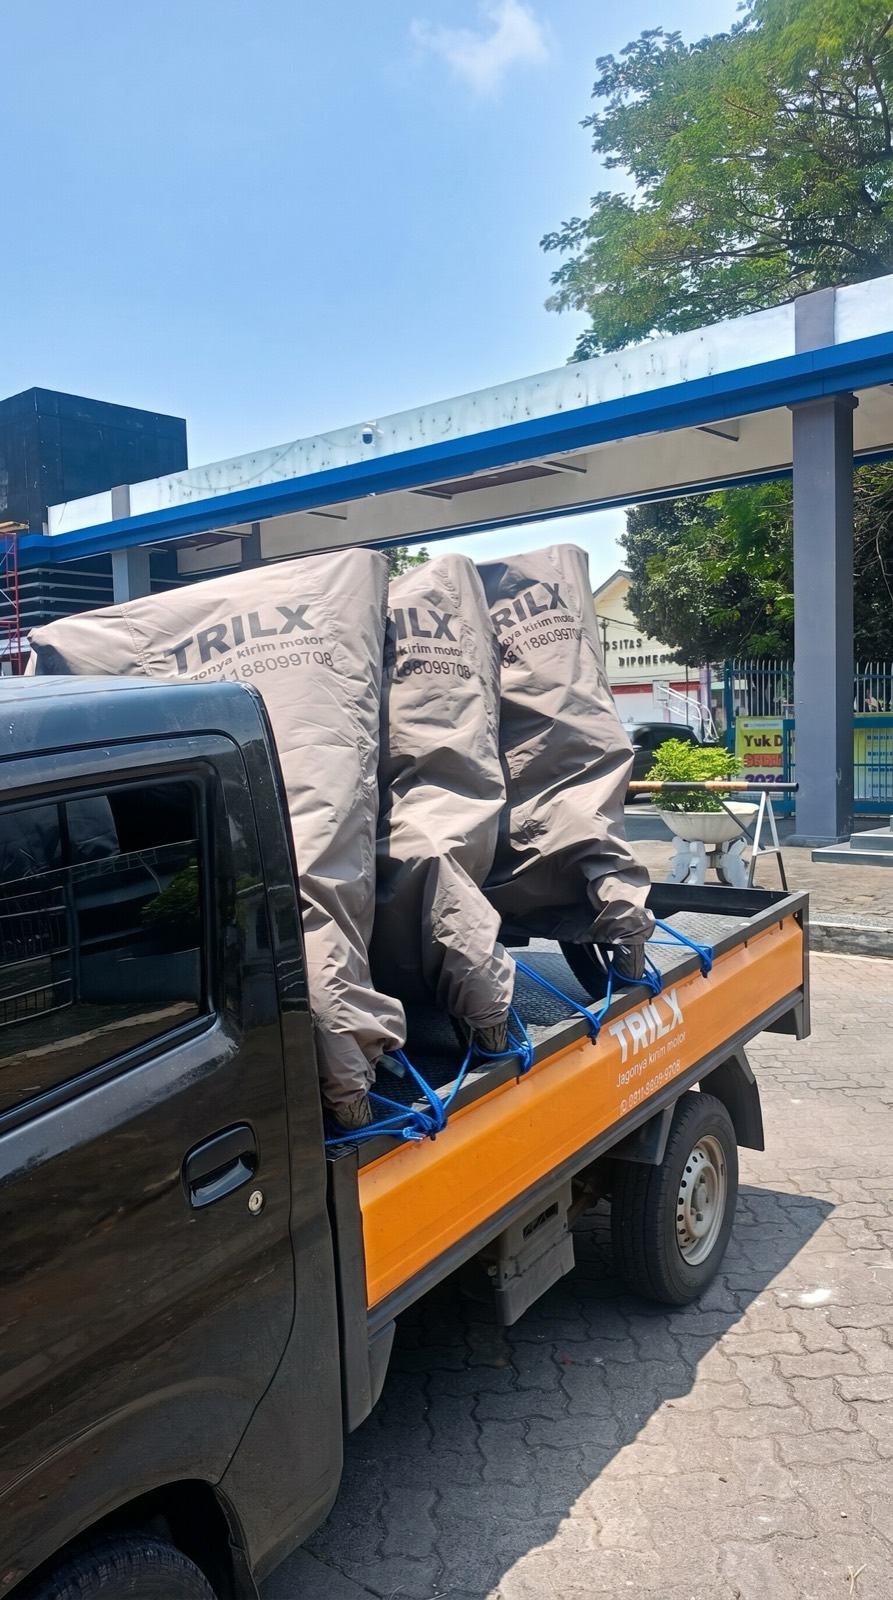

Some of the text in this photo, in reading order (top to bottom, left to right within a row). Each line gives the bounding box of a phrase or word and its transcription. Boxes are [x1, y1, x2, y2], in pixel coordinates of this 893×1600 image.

[522, 618, 553, 634] kirim
[163, 604, 315, 675] TRILX
[236, 643, 276, 660] kirim
[280, 636, 325, 650] motor
[398, 643, 432, 656] kirim
[744, 735, 772, 747] Yuk
[608, 988, 684, 1064] TRILX
[616, 1058, 648, 1088] Jagonya
